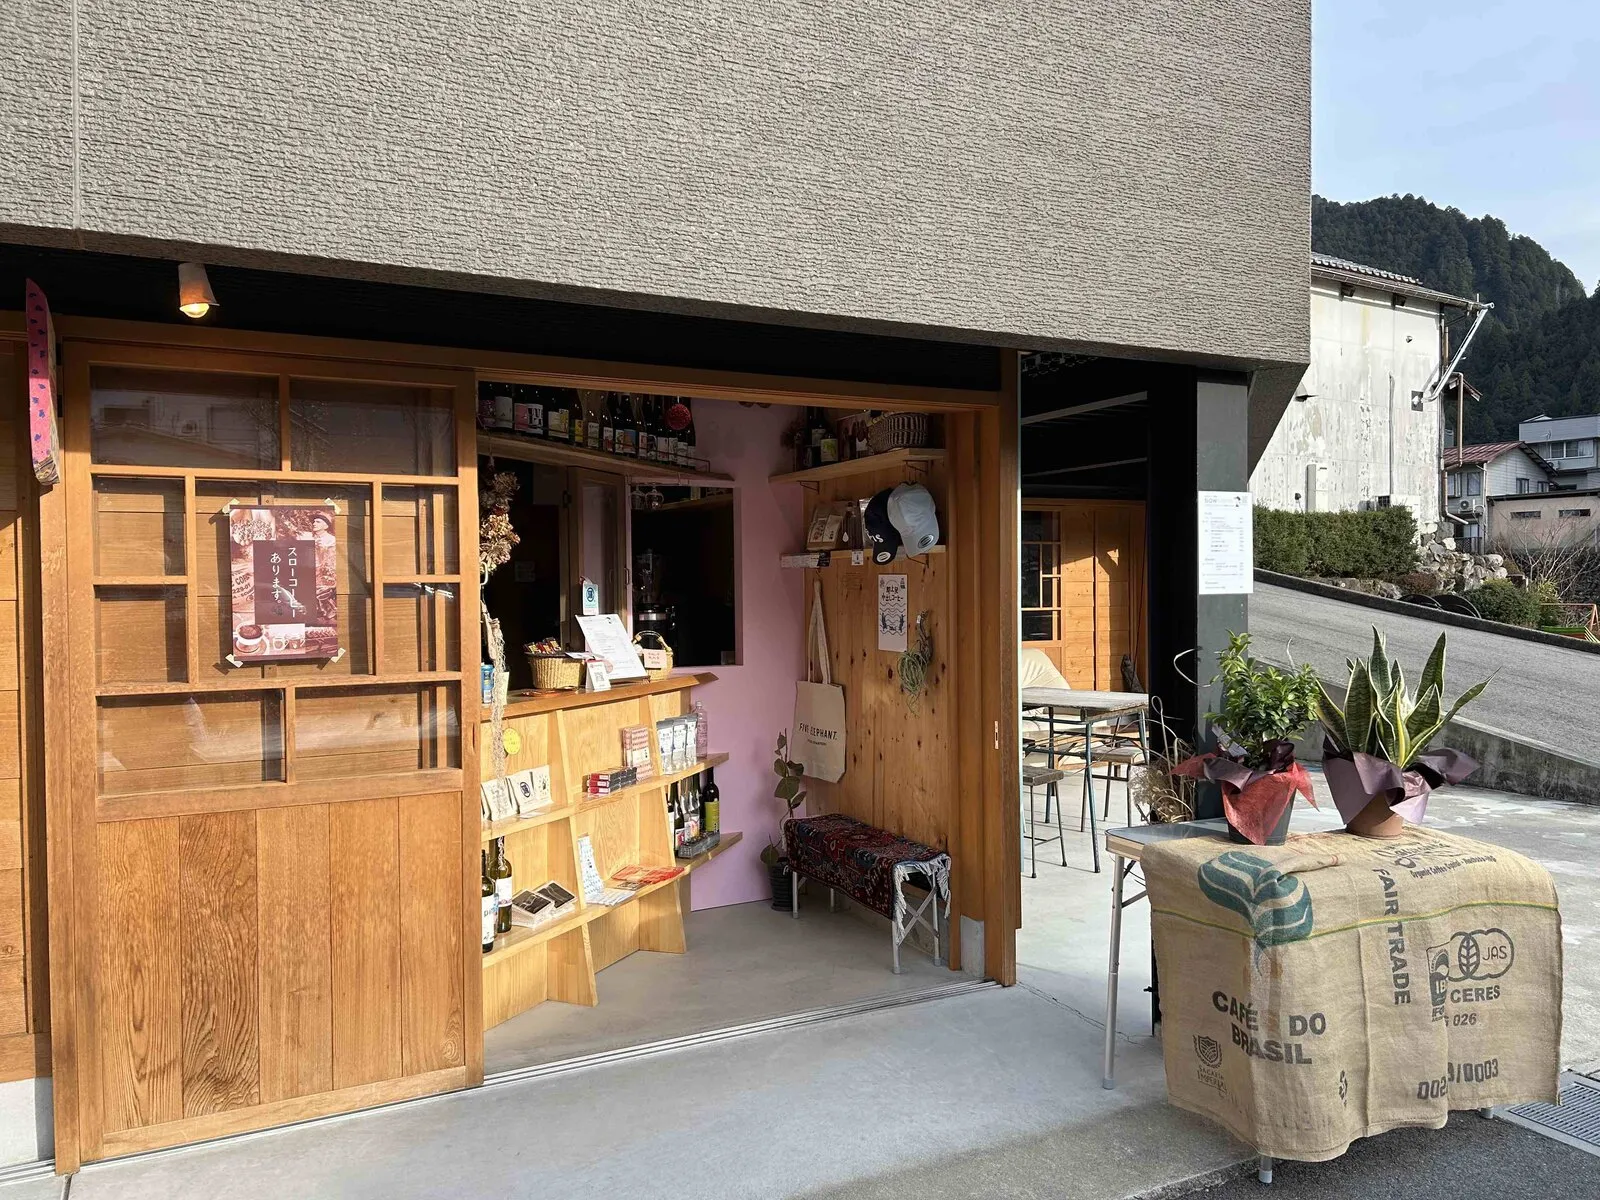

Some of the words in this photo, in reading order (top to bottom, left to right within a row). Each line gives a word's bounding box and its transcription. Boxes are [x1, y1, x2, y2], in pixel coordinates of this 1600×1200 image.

[1482, 945, 1508, 961] JAS
[1450, 984, 1501, 1004] CERES
[1212, 990, 1259, 1032] CAFÉ
[1288, 1012, 1326, 1037] DO
[1453, 1012, 1477, 1027] 026
[1231, 1022, 1313, 1065] BRASIL
